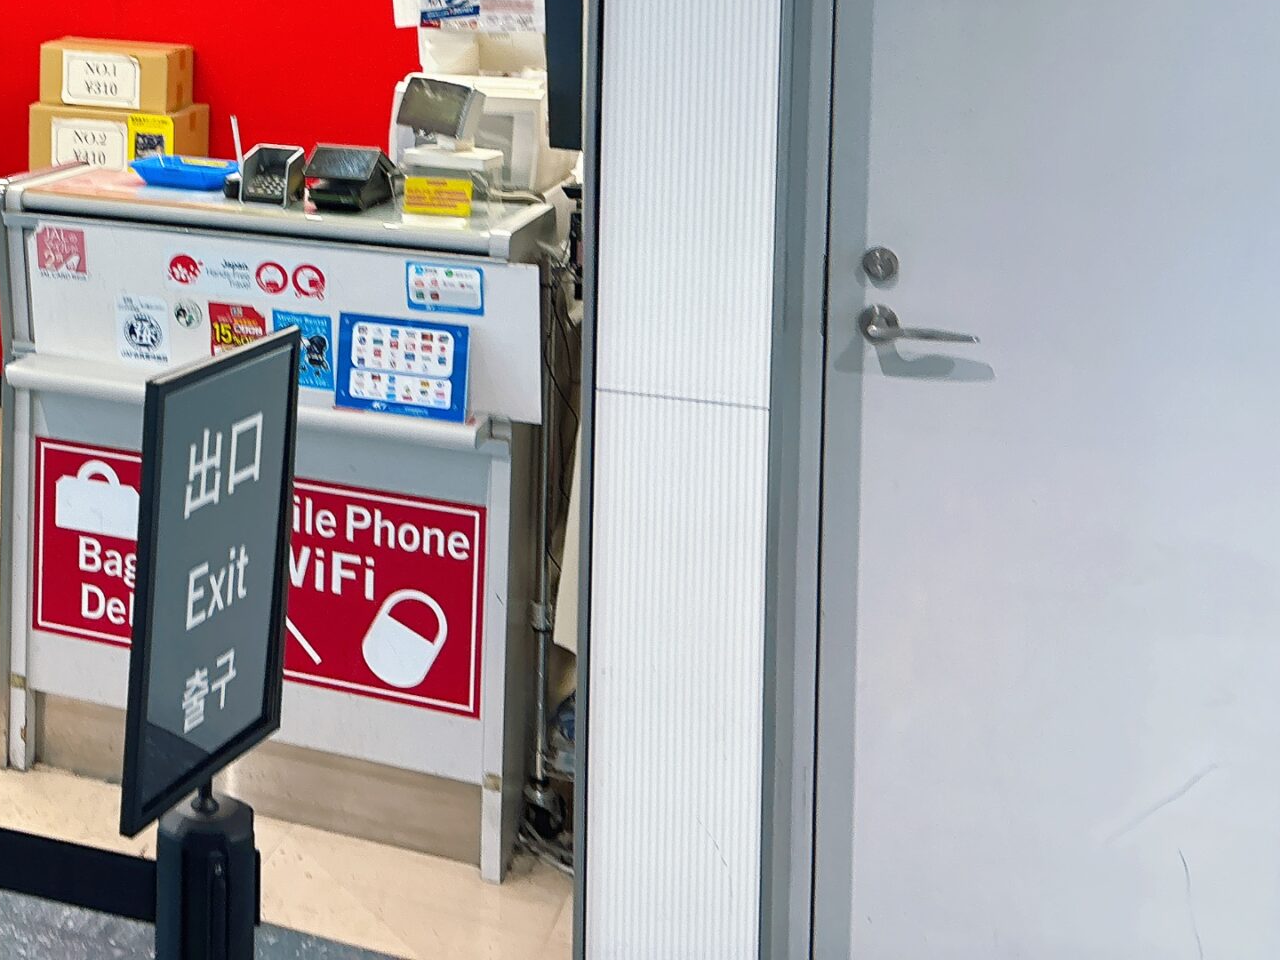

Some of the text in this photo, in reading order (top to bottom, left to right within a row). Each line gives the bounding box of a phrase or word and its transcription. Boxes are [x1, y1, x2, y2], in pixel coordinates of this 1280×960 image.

[85, 61, 117, 78] NO.1
[85, 80, 118, 97] ¥310
[73, 130, 107, 147] NO.2
[213, 321, 233, 344] 15
[183, 412, 264, 520] 出口
[292, 494, 471, 561] ile Phone
[185, 543, 249, 632] Exit
[182, 647, 237, 734] 출구
